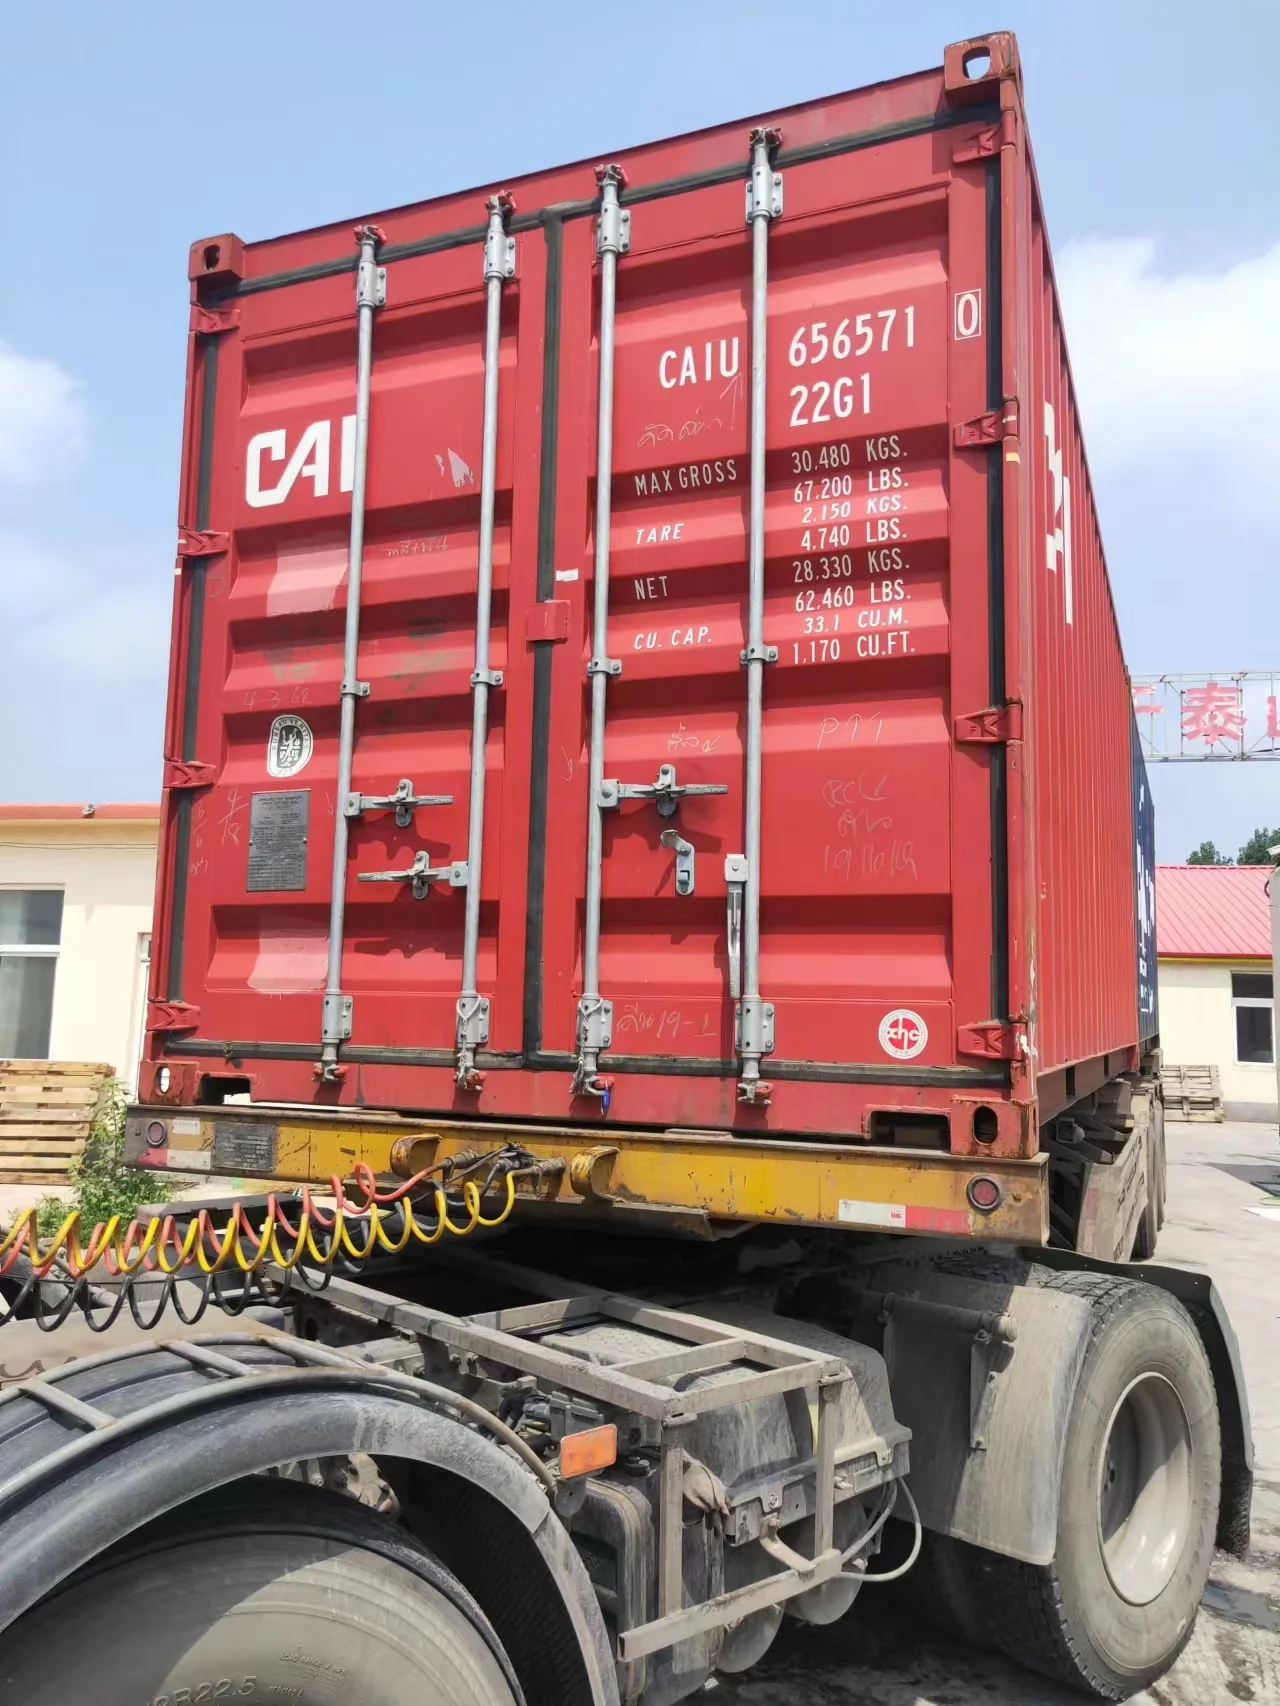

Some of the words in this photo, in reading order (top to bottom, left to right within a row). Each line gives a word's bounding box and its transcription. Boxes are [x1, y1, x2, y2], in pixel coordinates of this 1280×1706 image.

[659, 337, 739, 389] CAIU
[788, 305, 915, 367] 656571
[957, 294, 978, 336] 0
[789, 372, 871, 427] 22G1
[246, 415, 357, 507] CAI
[634, 469, 673, 496] MAX
[678, 459, 737, 489] GROSS
[865, 434, 908, 462] KGS.
[868, 467, 909, 493] LBS.
[636, 523, 685, 545] TARE
[866, 495, 908, 515] KGS.
[866, 517, 907, 543] LBS.
[634, 575, 668, 601] NET
[867, 547, 910, 574] KGS.
[870, 578, 912, 604] LBS.
[634, 630, 663, 650] CU.
[671, 626, 712, 646] CAP.
[803, 613, 840, 635] 33.1
[857, 606, 909, 629] CU.M.
[856, 630, 916, 658] CU.FT.
[146, 1675, 257, 1706] 2R22.5
